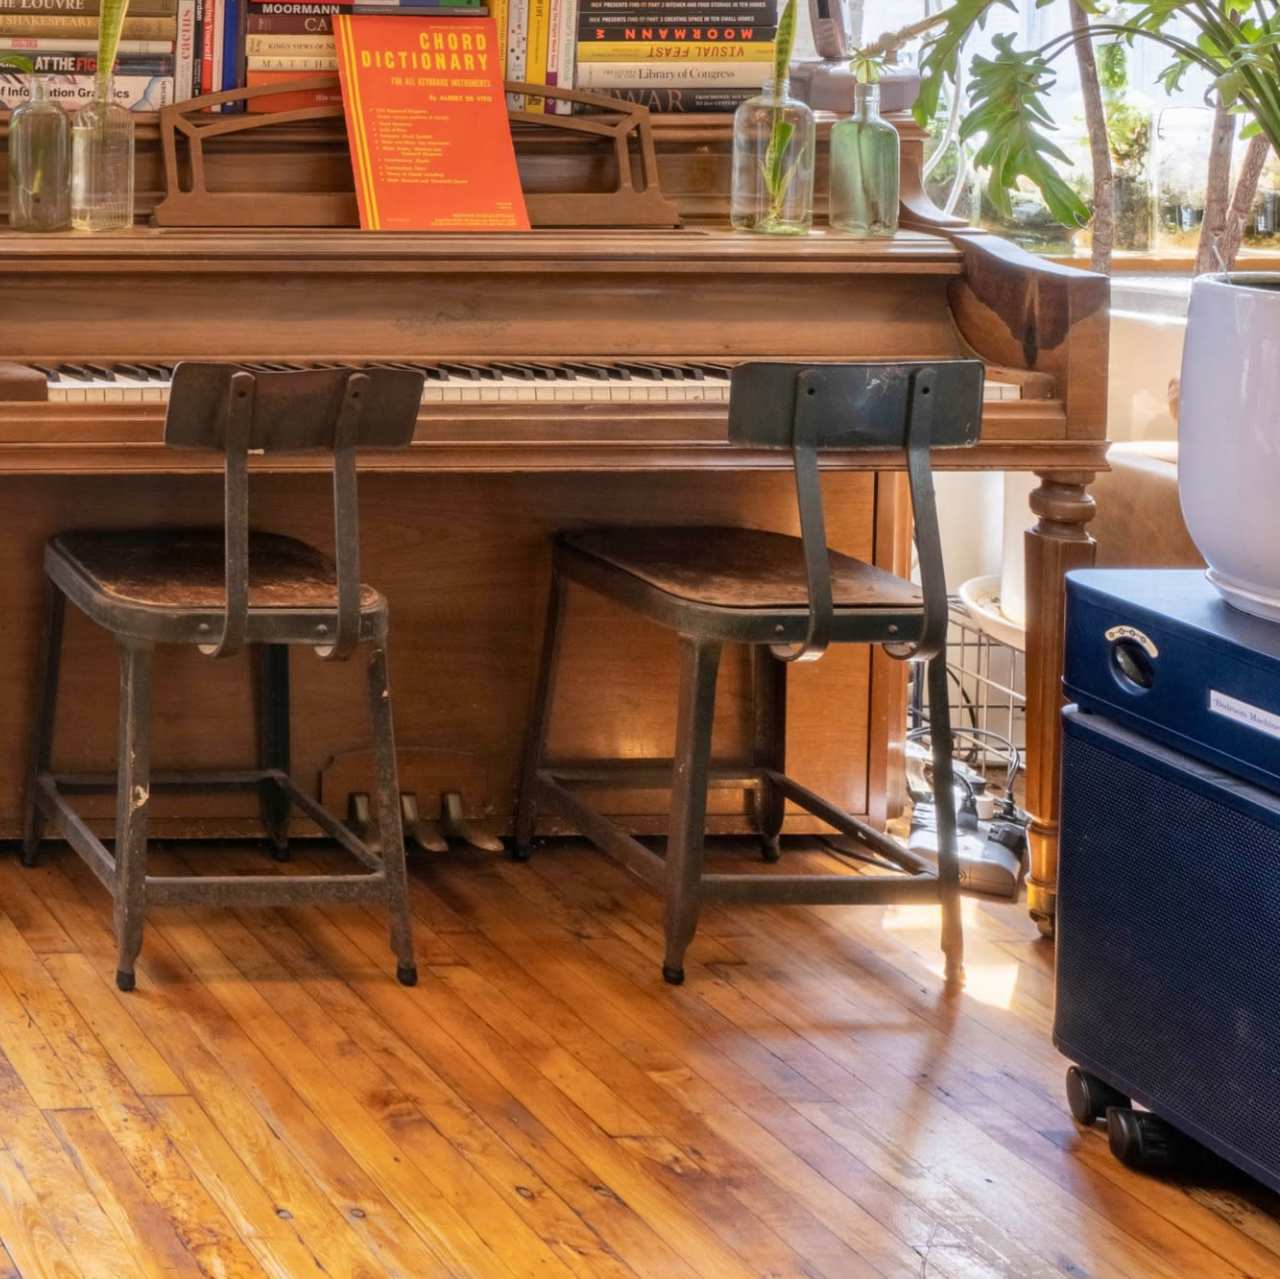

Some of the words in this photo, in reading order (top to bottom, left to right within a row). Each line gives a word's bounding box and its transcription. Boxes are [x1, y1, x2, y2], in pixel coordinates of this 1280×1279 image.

[262, 3, 340, 15] MOORMANN
[624, 28, 754, 40] MOORMANN
[204, 23, 213, 61] Yourself
[419, 32, 487, 51] CHORD
[647, 46, 690, 58] FEAST
[695, 46, 745, 57] VISUAL
[47, 56, 76, 71] THE
[76, 56, 120, 71] FIGS
[361, 50, 488, 71] DICTIONARY
[638, 68, 675, 81] Library
[677, 68, 688, 79] of
[689, 69, 736, 81] Congress
[7, 87, 75, 98] Infotion
